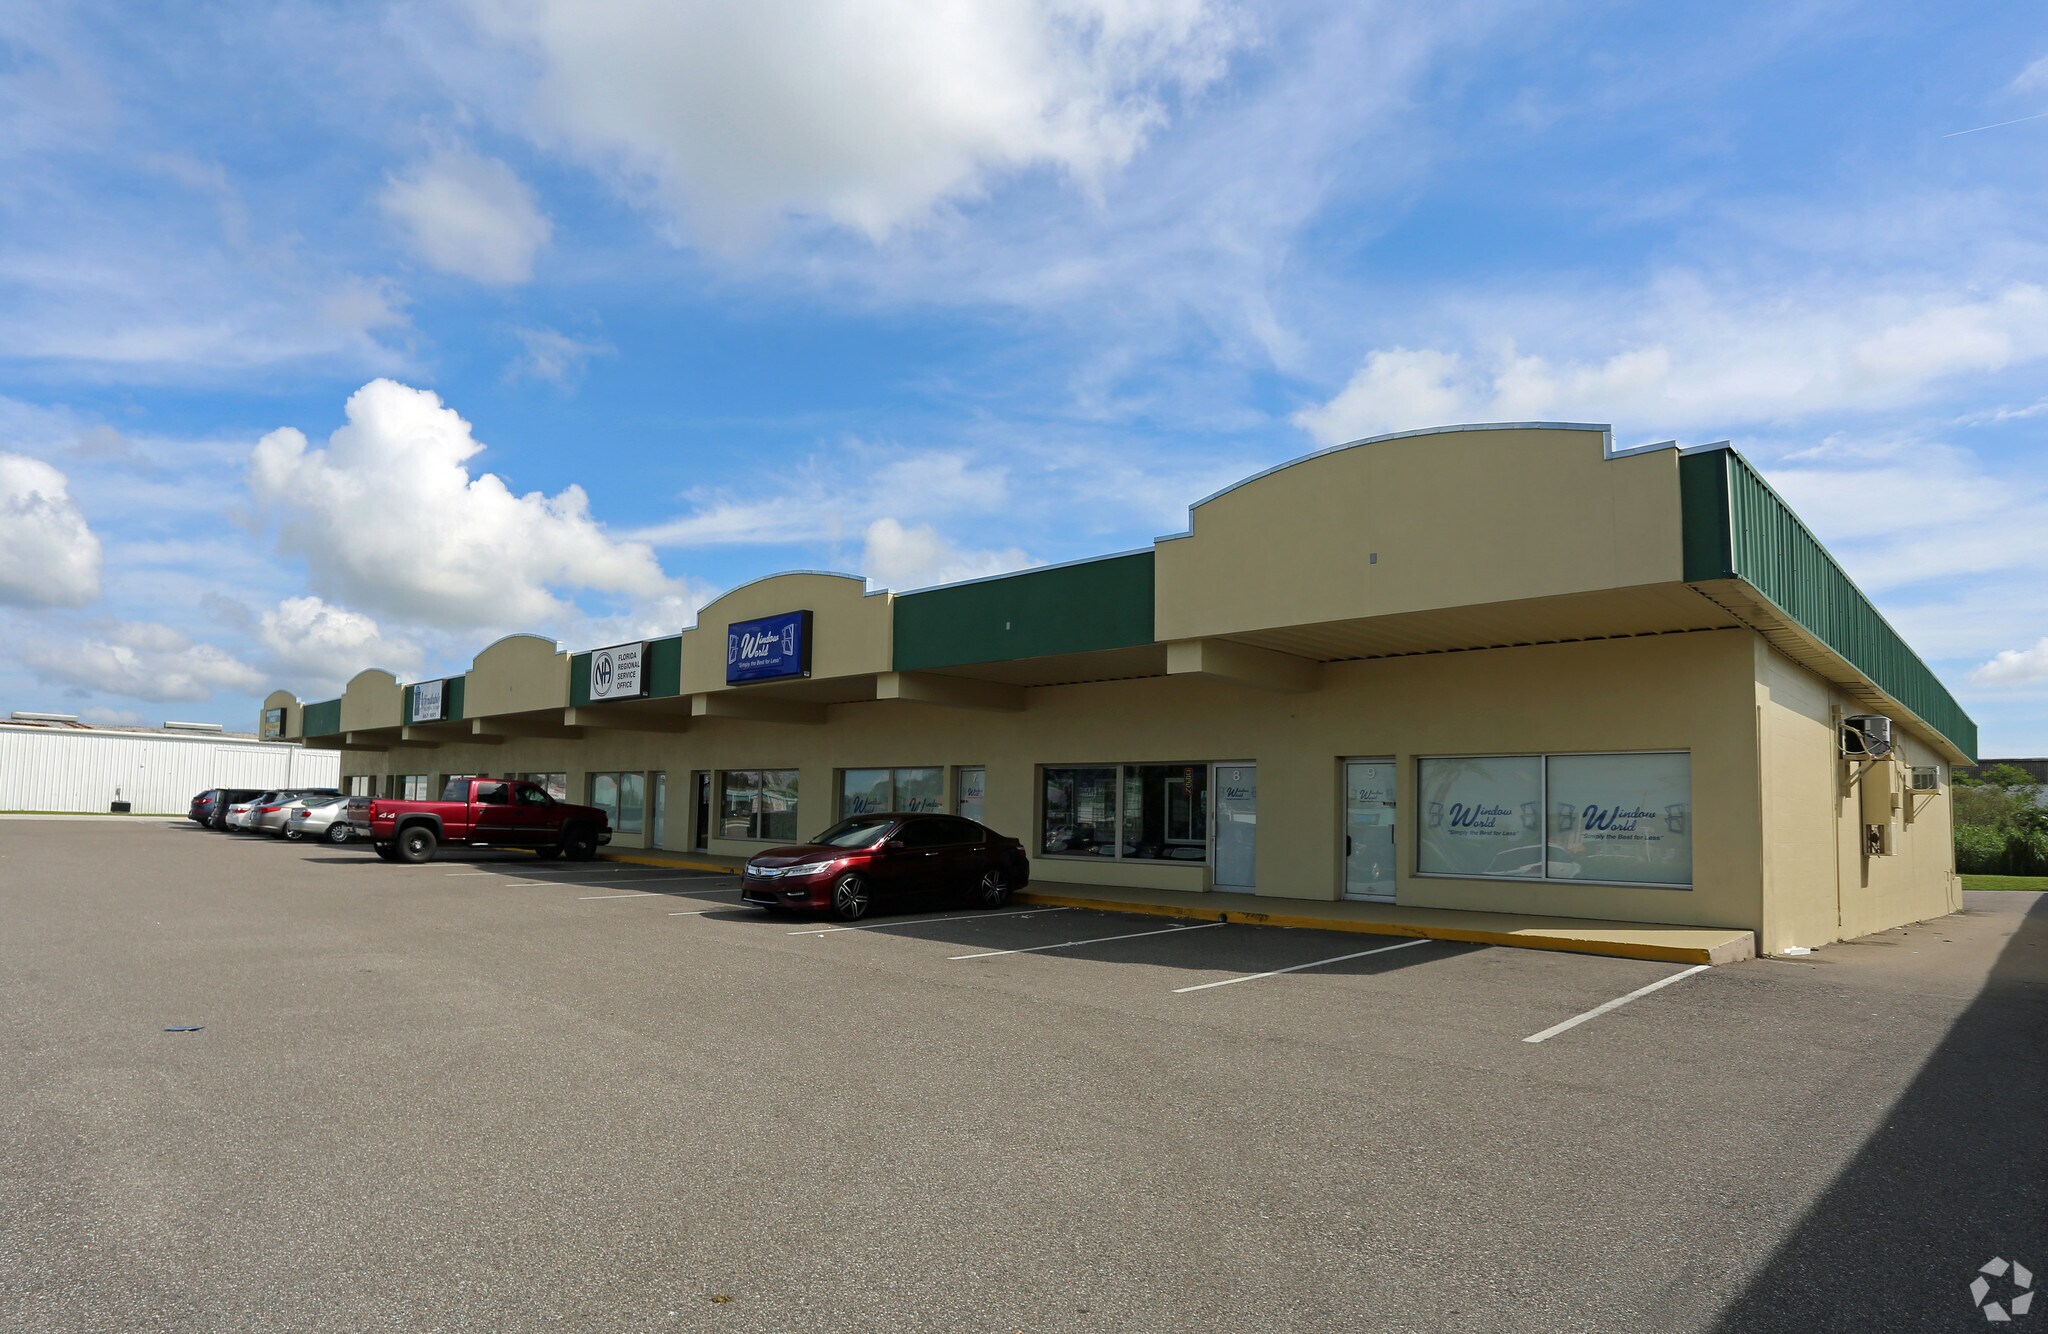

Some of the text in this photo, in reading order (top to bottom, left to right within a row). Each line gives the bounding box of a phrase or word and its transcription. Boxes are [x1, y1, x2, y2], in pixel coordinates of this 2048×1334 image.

[741, 631, 779, 659] Window
[618, 652, 637, 661] FLORIDA
[617, 661, 640, 670] REGIONAL
[617, 671, 636, 680] SERVICE
[617, 681, 632, 689] OFFICE
[972, 773, 977, 782] 7
[1233, 770, 1240, 781] 8
[1367, 767, 1375, 778] 9
[1449, 802, 1512, 827] Window
[1583, 804, 1656, 830] Window
